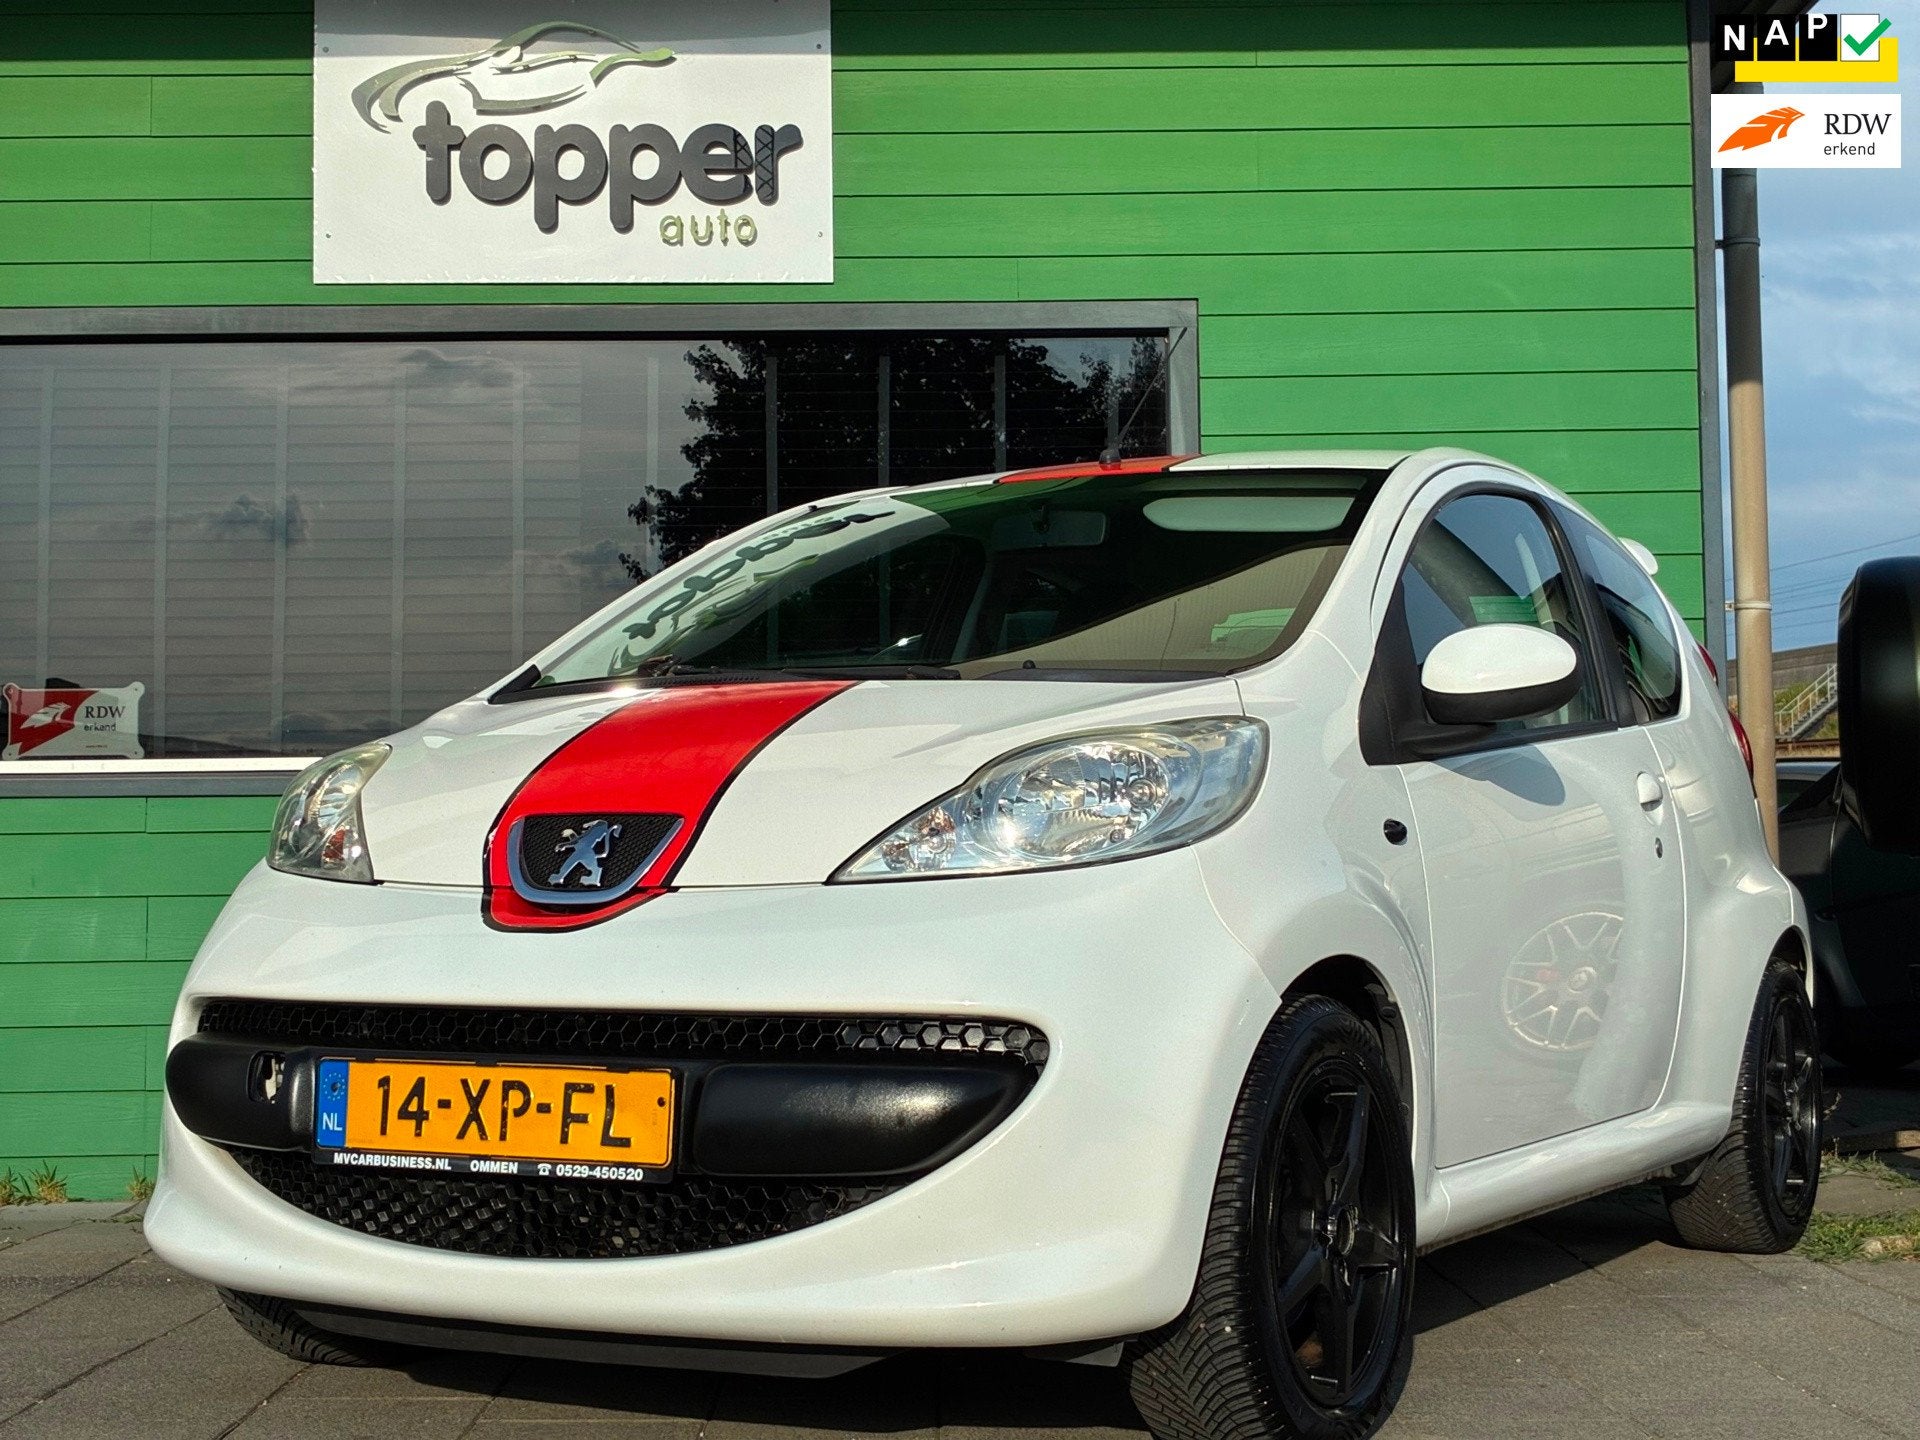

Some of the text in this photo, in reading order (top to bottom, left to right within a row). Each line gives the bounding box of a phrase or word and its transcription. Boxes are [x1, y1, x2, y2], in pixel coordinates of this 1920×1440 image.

[412, 101, 804, 234] topper
[658, 208, 758, 247] auto
[84, 706, 126, 719] RDW
[322, 1113, 343, 1132] NL
[376, 1075, 632, 1148] 14-XP-FL
[469, 1160, 519, 1175] OMMEN
[555, 1164, 645, 1182] 0529-450520
